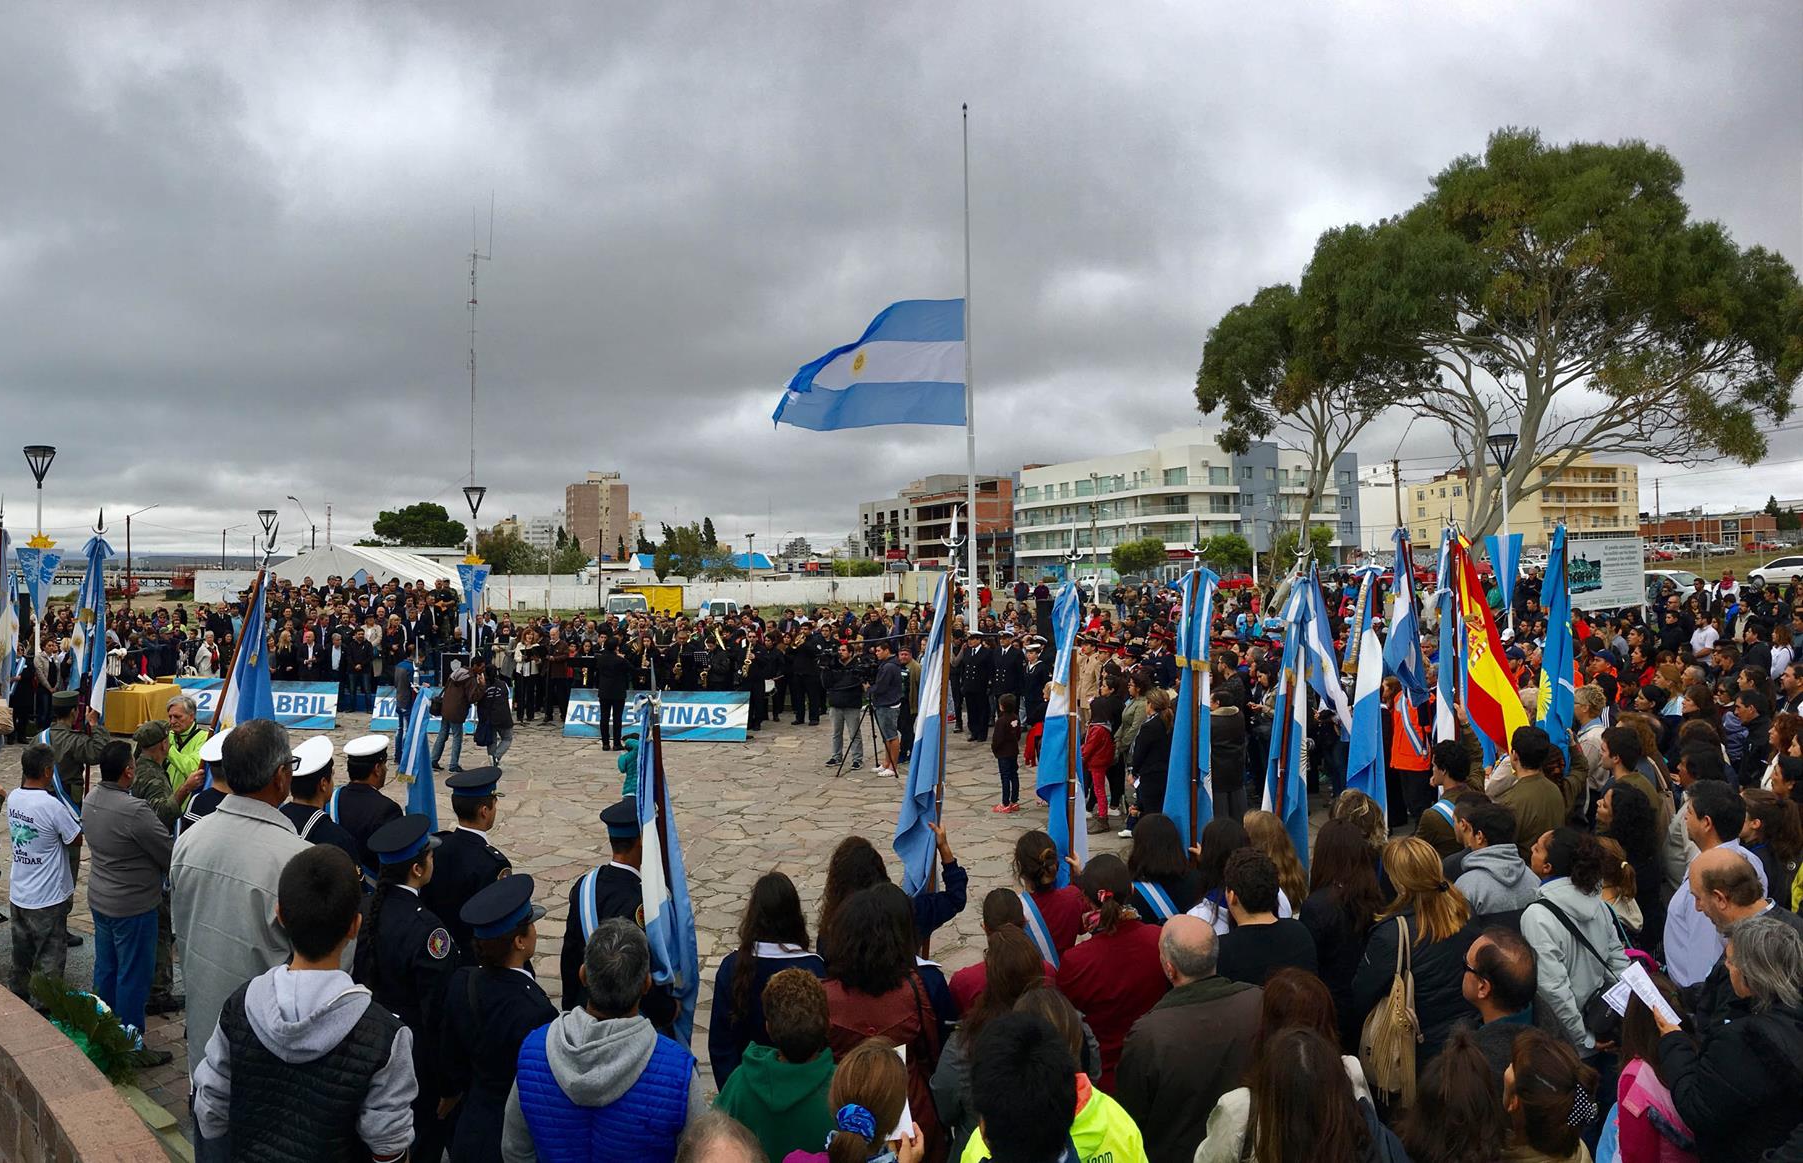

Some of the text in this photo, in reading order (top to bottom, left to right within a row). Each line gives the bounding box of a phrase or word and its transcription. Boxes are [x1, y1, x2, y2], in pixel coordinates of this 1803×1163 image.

[197, 692, 332, 714] 2 BRIL
[570, 704, 727, 725] ARETINAS
[9, 809, 34, 823] Malvinas
[13, 854, 42, 864] LVIDAR
